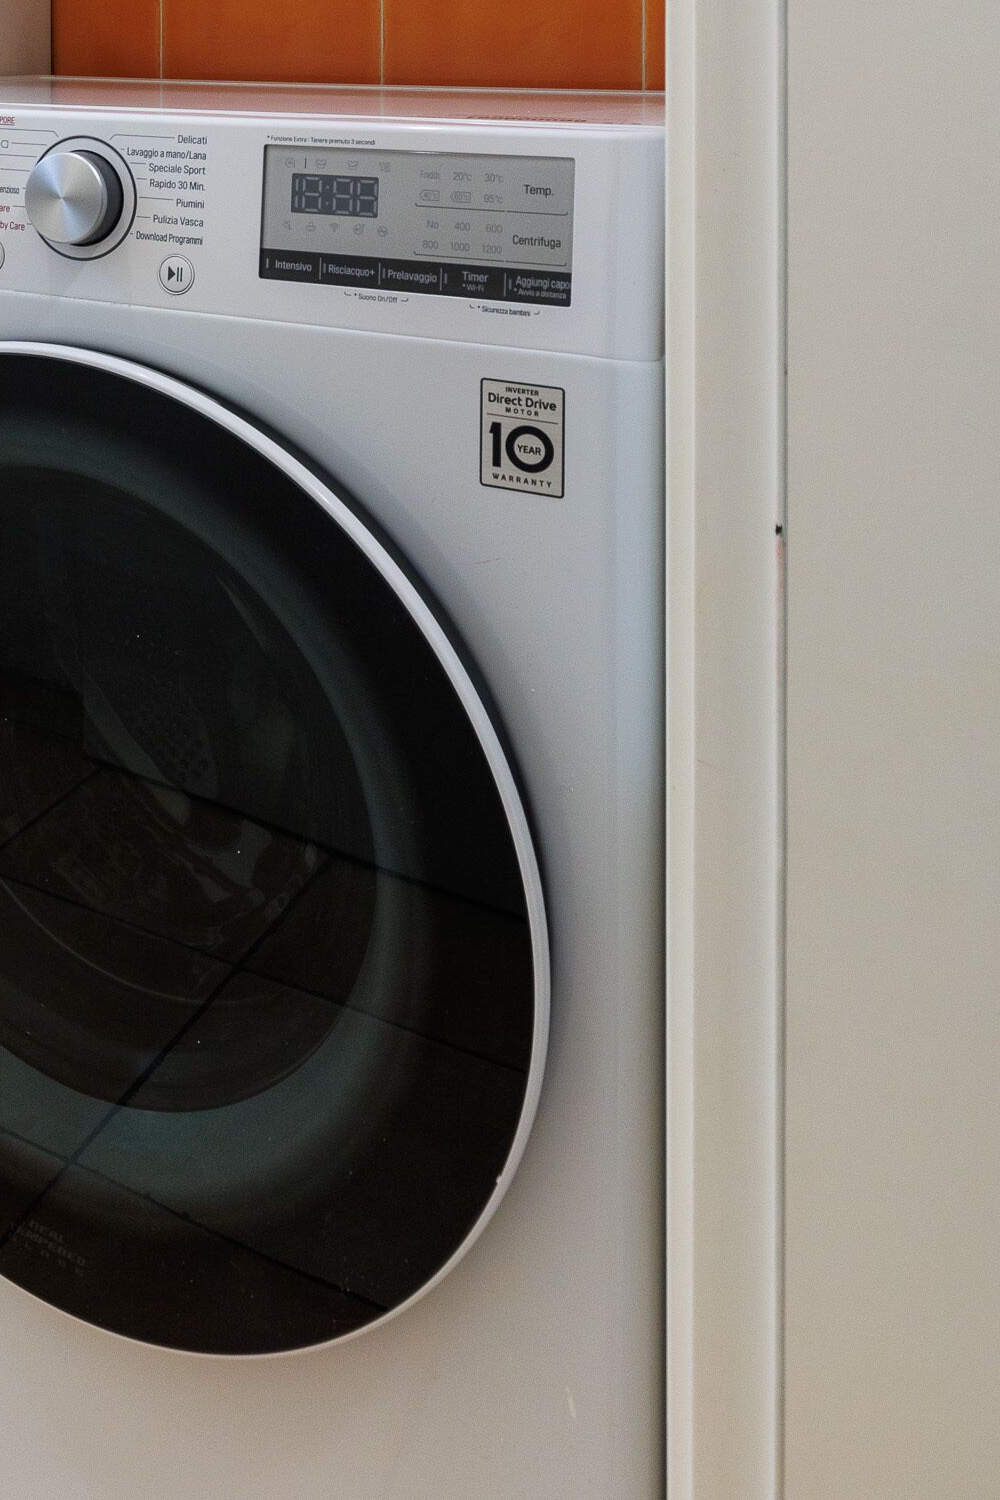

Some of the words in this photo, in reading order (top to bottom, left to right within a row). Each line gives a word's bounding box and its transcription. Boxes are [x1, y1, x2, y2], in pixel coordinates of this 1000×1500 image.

[177, 134, 208, 145] Delicati
[127, 148, 159, 159] Lavaggio
[160, 150, 165, 158] a
[166, 150, 207, 160] mano/Lana
[149, 162, 182, 173] Speciale
[183, 164, 206, 175] Sport
[149, 178, 177, 190] Rapido
[177, 180, 187, 190] 30
[189, 181, 206, 191] Min.
[523, 184, 555, 197] Temp.
[176, 197, 205, 209] Piumini
[9, 221, 26, 231] Care
[153, 214, 178, 225] Pulizia
[180, 216, 204, 227] Vasca
[426, 219, 440, 230] No
[454, 220, 471, 232] 400
[486, 222, 503, 234] 600
[136, 230, 167, 242] Download
[168, 233, 204, 245] Programmi
[512, 234, 562, 250] Centrifuga
[422, 239, 439, 250] 800
[450, 241, 471, 253] 1000
[482, 243, 503, 255] 1200
[275, 259, 313, 272] Intensivo
[328, 263, 376, 277] Risciacquo+
[387, 269, 438, 284] Prelavaggio
[461, 270, 489, 283] Timer
[515, 275, 550, 290] Aggiungi
[550, 278, 570, 291] capo
[466, 283, 485, 292] Wi-Fi
[518, 287, 536, 297] Avvio
[540, 289, 567, 299] distanza
[358, 293, 377, 302] Suono
[377, 294, 398, 303] On/Off
[481, 305, 509, 315] Sicurezza
[508, 308, 531, 317] bambini
[505, 386, 540, 396] INVERTER
[488, 392, 522, 406] Direct
[525, 397, 557, 411] Drive
[505, 406, 539, 417] MOTOR
[489, 421, 554, 473] 10
[517, 443, 542, 456] YEAR
[492, 472, 552, 488] WARRANTY
